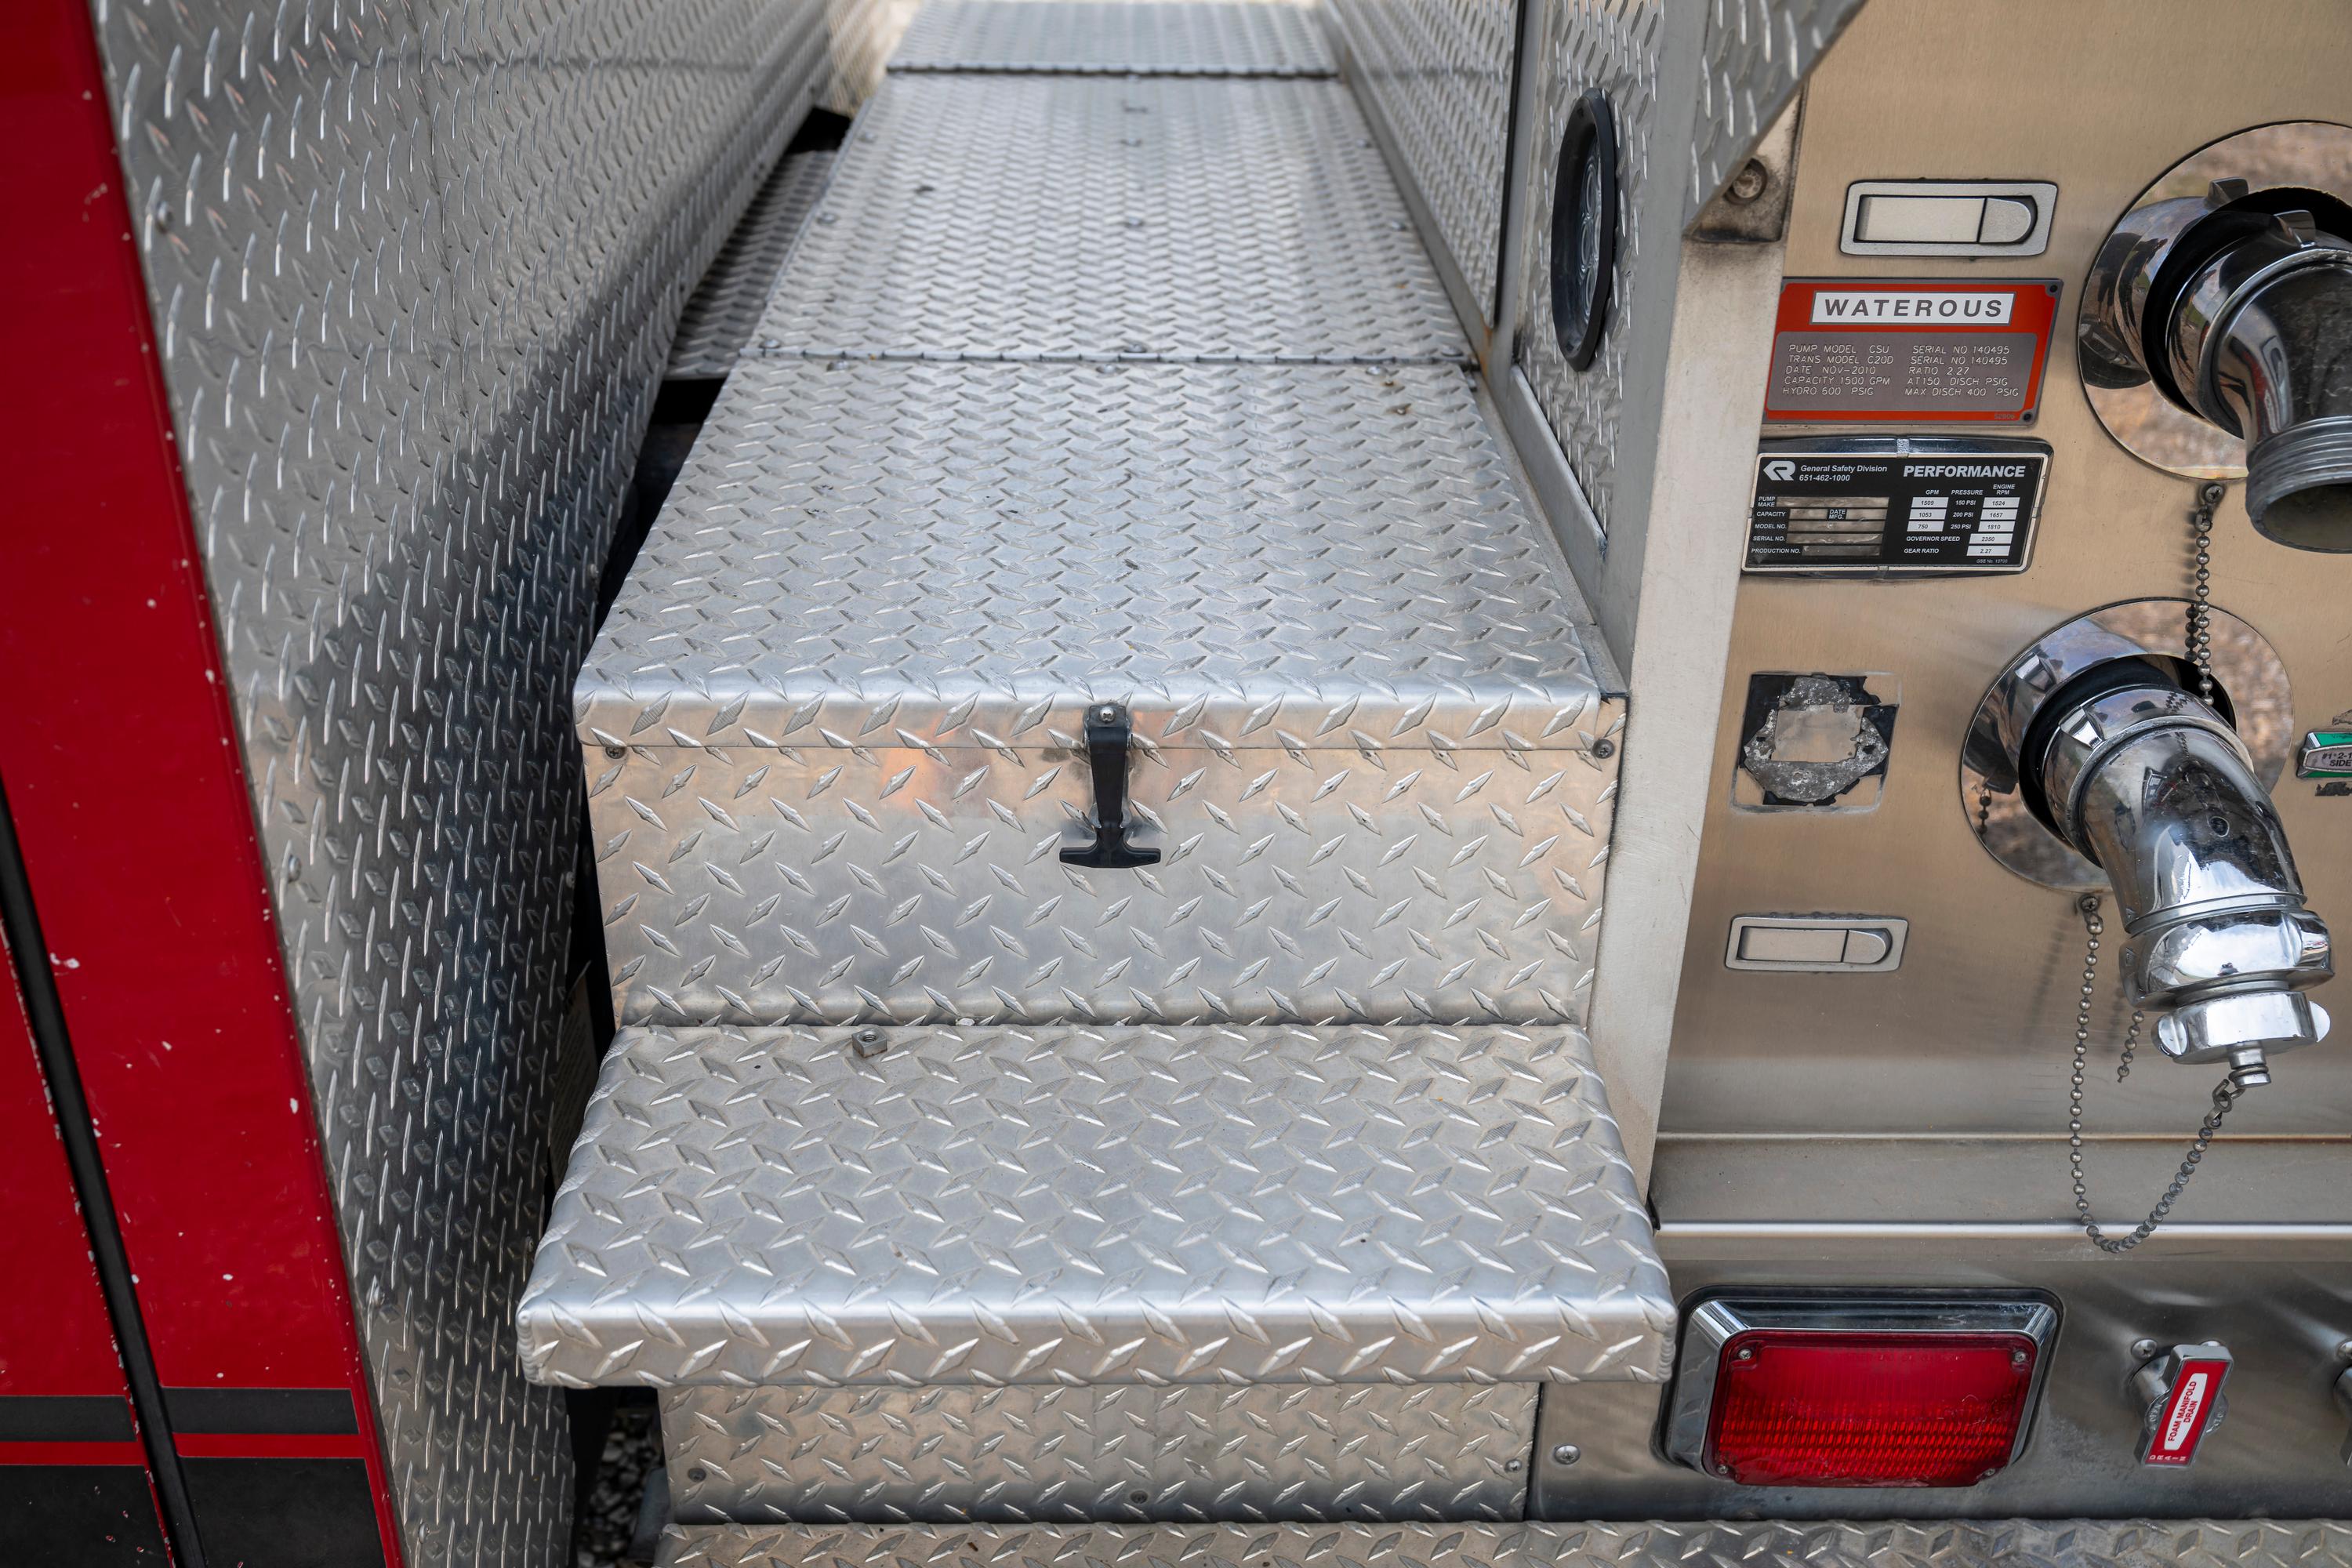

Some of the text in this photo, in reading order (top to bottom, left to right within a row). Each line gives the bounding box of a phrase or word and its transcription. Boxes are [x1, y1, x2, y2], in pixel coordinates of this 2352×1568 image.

[1825, 299, 2002, 318] WATEROUS
[1788, 345, 1889, 354] PUMP MODEL CSU
[1912, 345, 2010, 354] SERIAL NO 140495
[1789, 355, 1894, 365] TRANS MODEL C20D
[1911, 356, 2008, 365] SERIAL NO 140495
[1785, 366, 1876, 375] DATE NOV-2010
[1908, 367, 1969, 376] RATIO 2.27
[1784, 376, 1890, 385] CAPACITY 1500 GPM
[1950, 377, 1980, 386] DISCH
[1985, 377, 2008, 386] PSIG
[1782, 387, 1875, 396] HYDRO 600 PSIG
[1904, 388, 2019, 397] MAX DISCH 400 PSIG
[1831, 465, 1855, 474] Safety
[1903, 466, 2026, 477] PERFORMANCE
[2168, 1381, 2197, 1441] FOAM MANIFOLD
[2183, 1400, 2198, 1423] DRAIN
